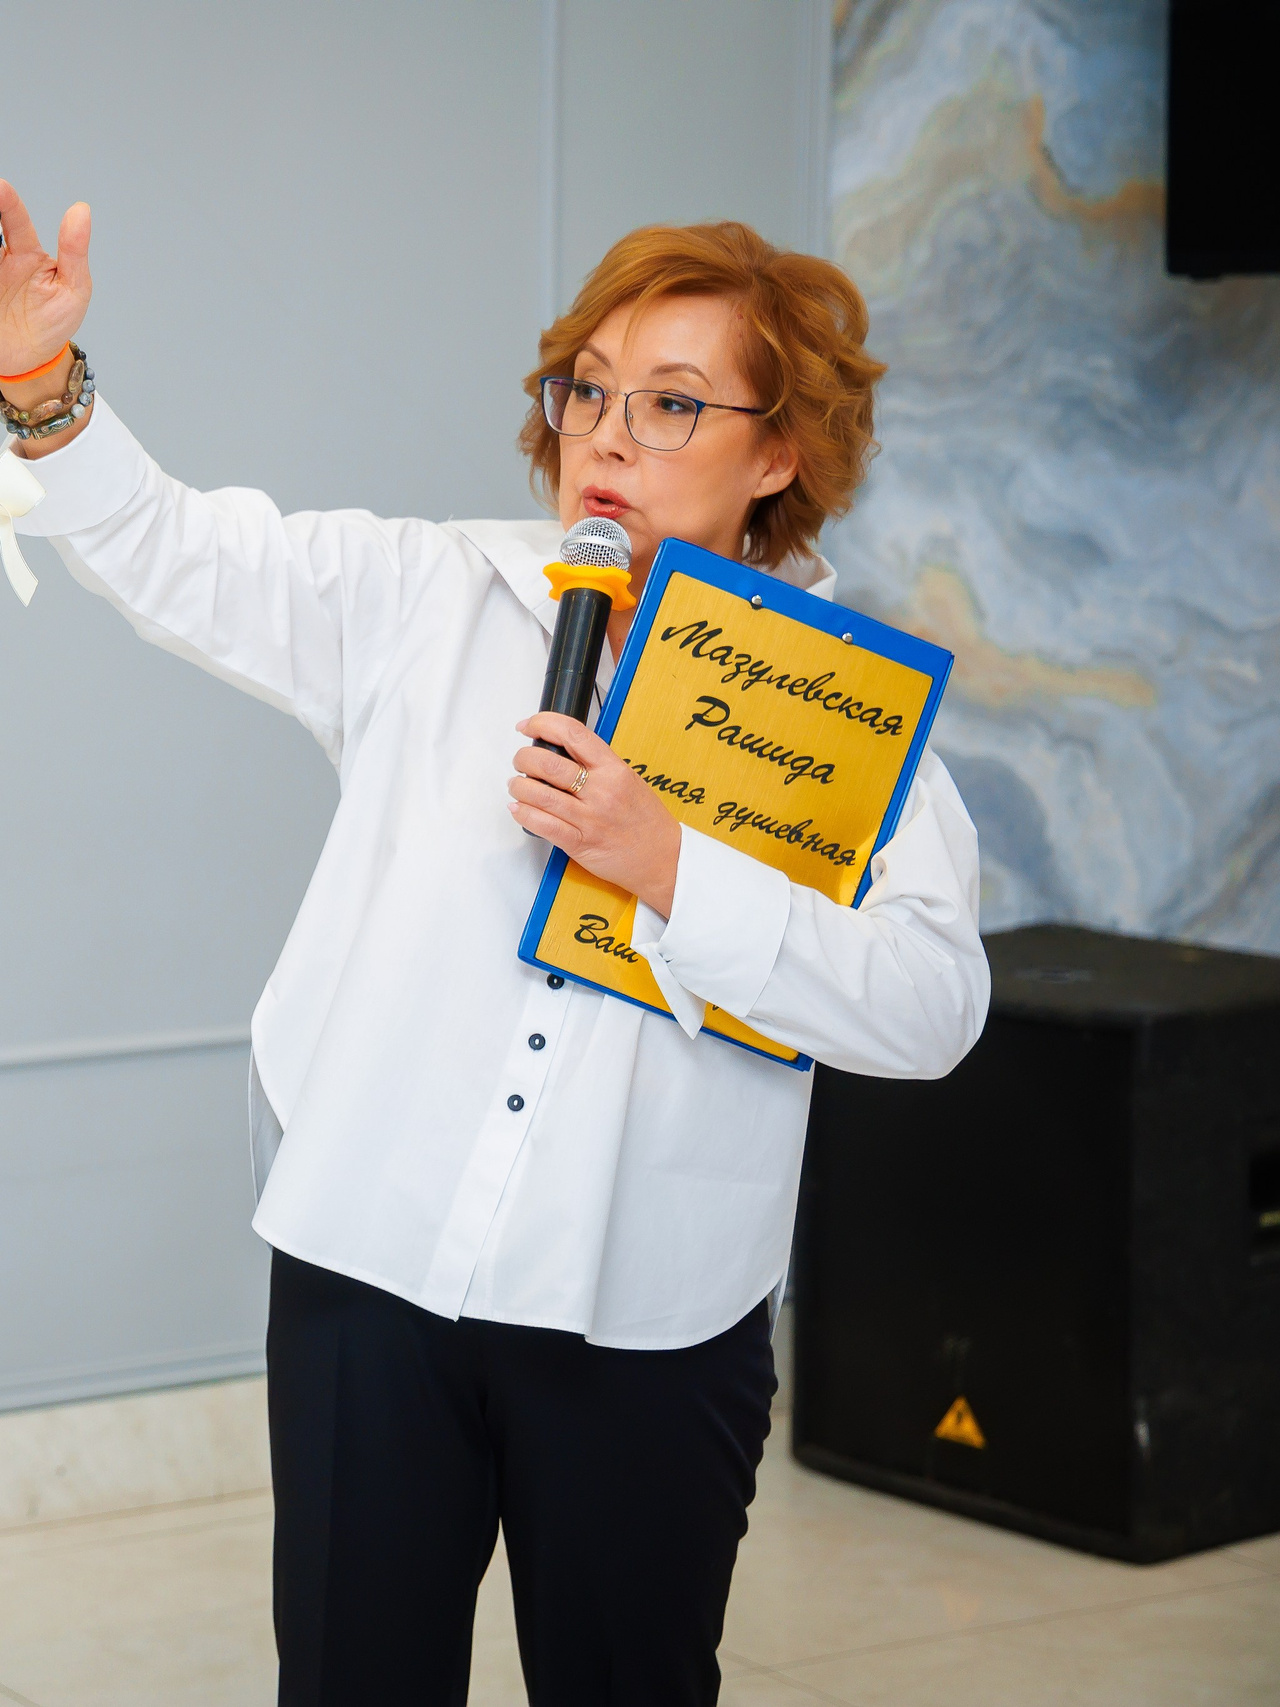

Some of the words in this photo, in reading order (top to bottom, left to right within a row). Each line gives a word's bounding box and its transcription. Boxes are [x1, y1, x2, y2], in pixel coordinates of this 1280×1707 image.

[660, 620, 903, 736] Мазулевская
[684, 695, 835, 785] Рашида
[622, 758, 705, 804] амая
[712, 801, 856, 866] душевная
[573, 913, 638, 963] Ваш
